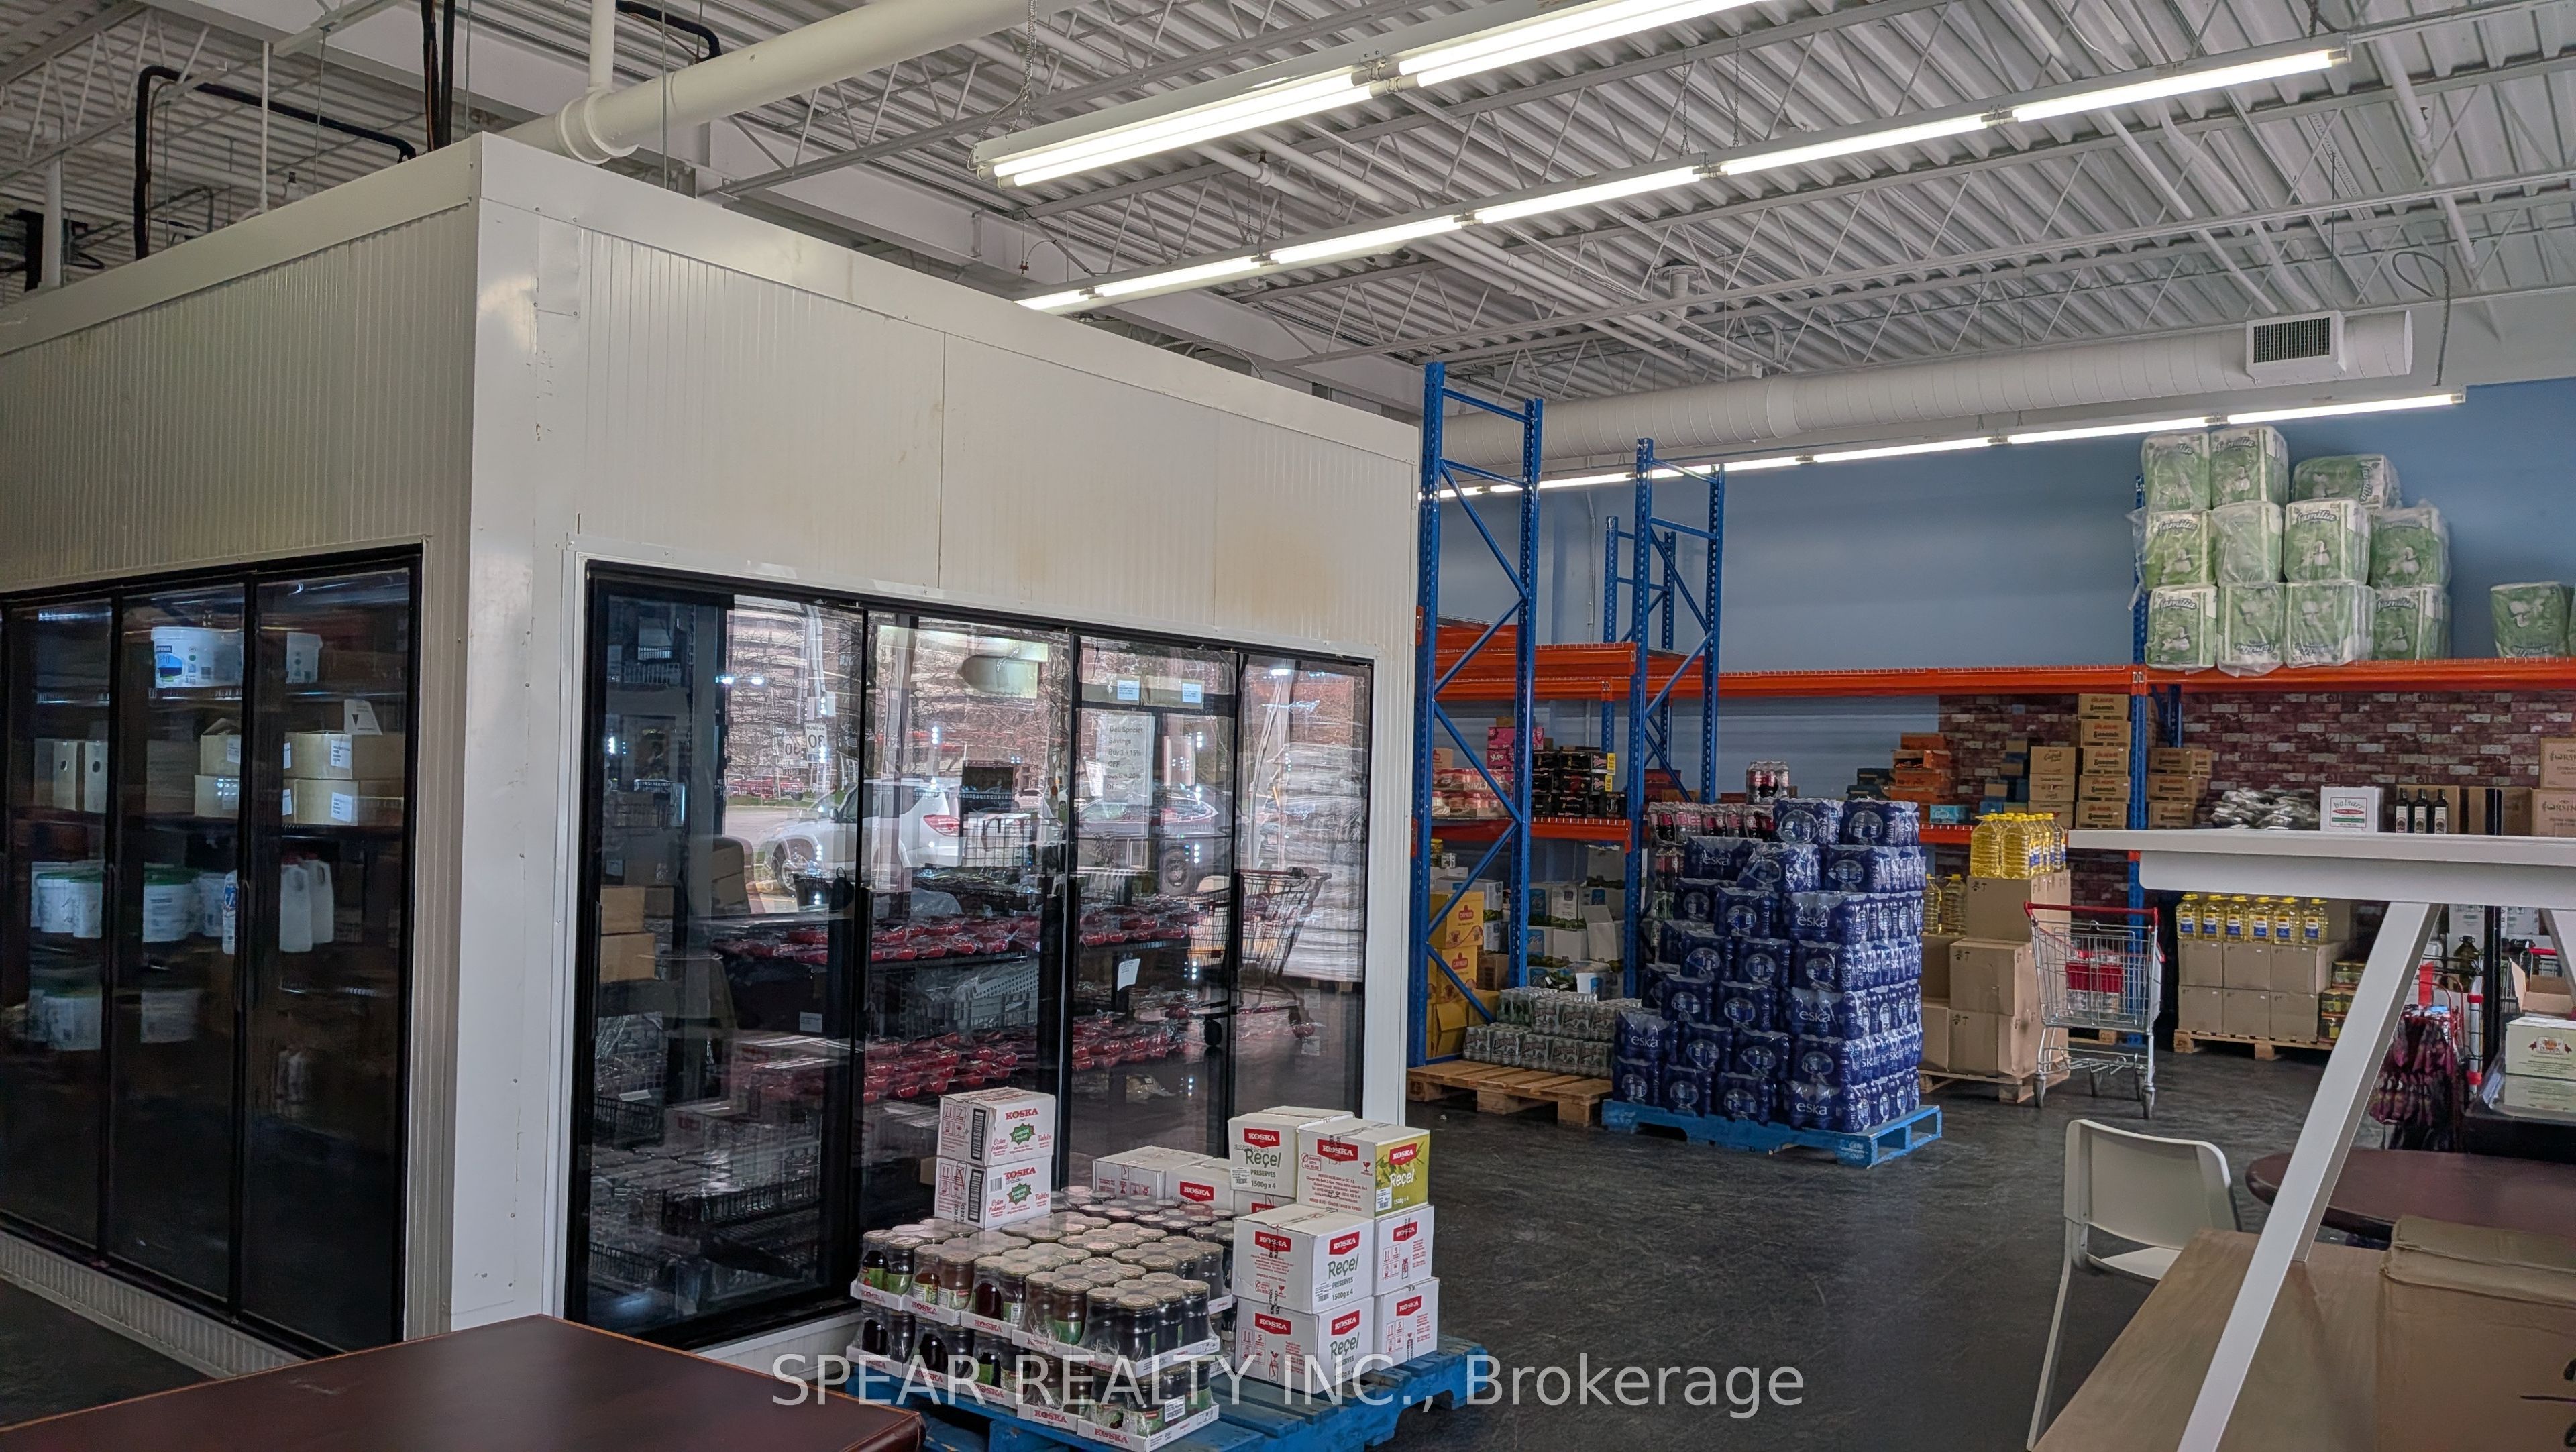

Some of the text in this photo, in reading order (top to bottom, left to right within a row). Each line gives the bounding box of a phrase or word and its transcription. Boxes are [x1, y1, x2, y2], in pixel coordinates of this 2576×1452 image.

[2297, 510, 2337, 526] familia
[2157, 520, 2198, 536] familia
[2159, 598, 2198, 610] familia
[1122, 726, 1143, 734] Special
[1797, 916, 1828, 928] eska
[1799, 1011, 1831, 1023] eska
[1631, 1036, 1659, 1048] eska
[1005, 1107, 1038, 1120] KOSKA
[1796, 1103, 1828, 1115] eska
[1248, 1133, 1277, 1142] KOSKA
[1322, 1145, 1354, 1157] KOSKA
[1393, 1148, 1414, 1160] KOSKA
[1244, 1148, 1281, 1168] Reçel
[1250, 1169, 1276, 1178] PRESERVES
[1389, 1169, 1415, 1188] Reçel
[1252, 1180, 1267, 1189] 1500g
[1183, 1186, 1211, 1197] KOSKA
[1333, 1237, 1356, 1250] KOSKA
[1327, 1253, 1359, 1279] Reçel
[1332, 1276, 1354, 1289] PRESERVES
[1332, 1292, 1346, 1301] 1500g
[912, 1301, 938, 1315] KOSKA
[1399, 1300, 1419, 1312] KOSKA
[974, 1319, 1003, 1333] KOSKA
[1259, 1318, 1287, 1330] KOSKA
[1334, 1316, 1357, 1329] KOSKA
[1330, 1332, 1360, 1360] Reçel
[1034, 1410, 1067, 1425] KOSKA
[1094, 1427, 1128, 1444] KOSKA
